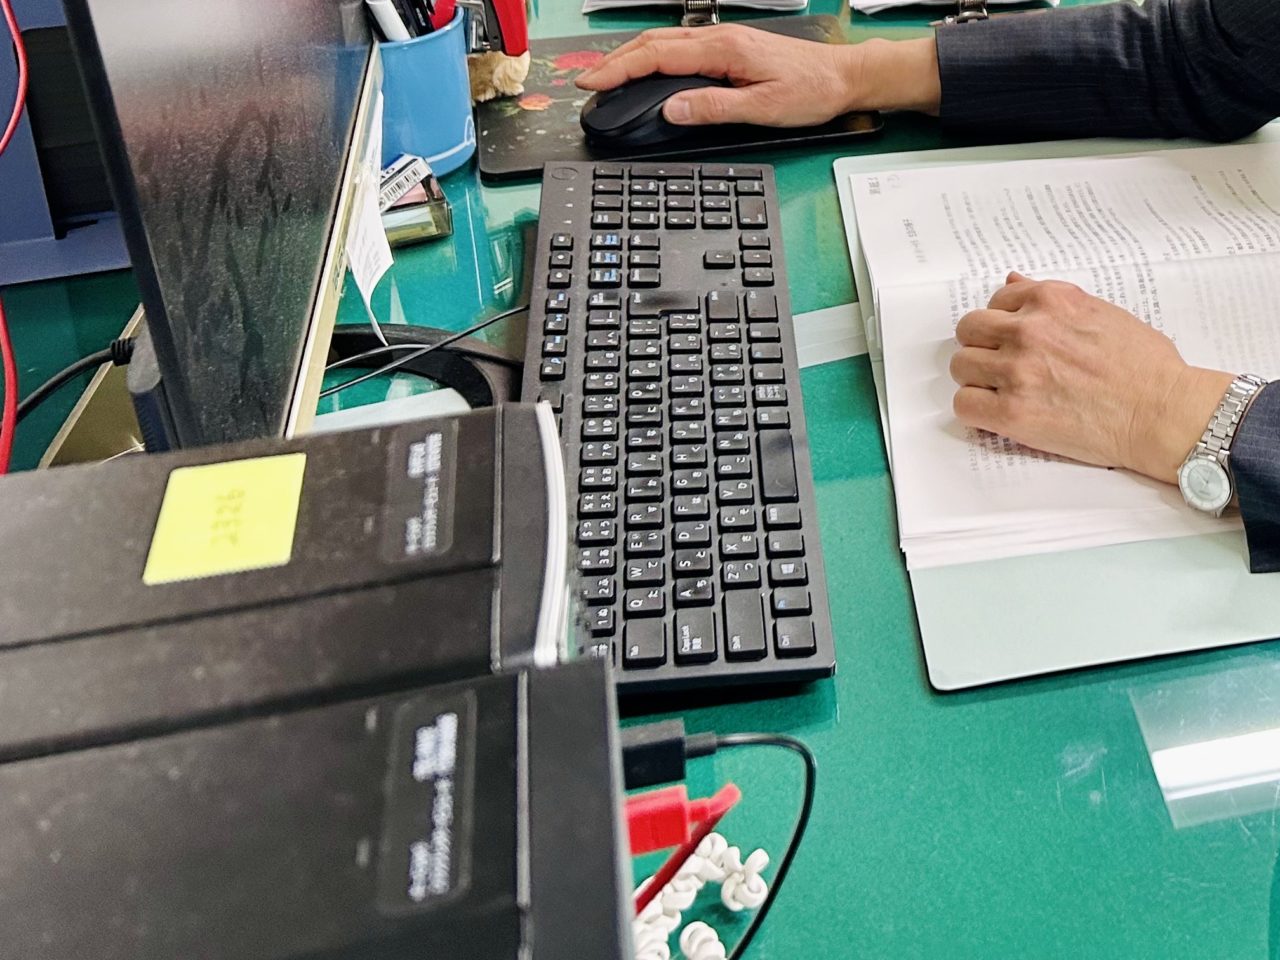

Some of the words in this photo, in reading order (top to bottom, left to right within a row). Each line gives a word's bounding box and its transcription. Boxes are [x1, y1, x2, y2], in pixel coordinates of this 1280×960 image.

[718, 416, 729, 424] M
[630, 437, 642, 445] U
[631, 487, 642, 495] T
[678, 532, 690, 540] D
[631, 567, 642, 578] W
[728, 572, 739, 580] Z
[680, 589, 692, 597] A
[630, 600, 643, 608] Q
